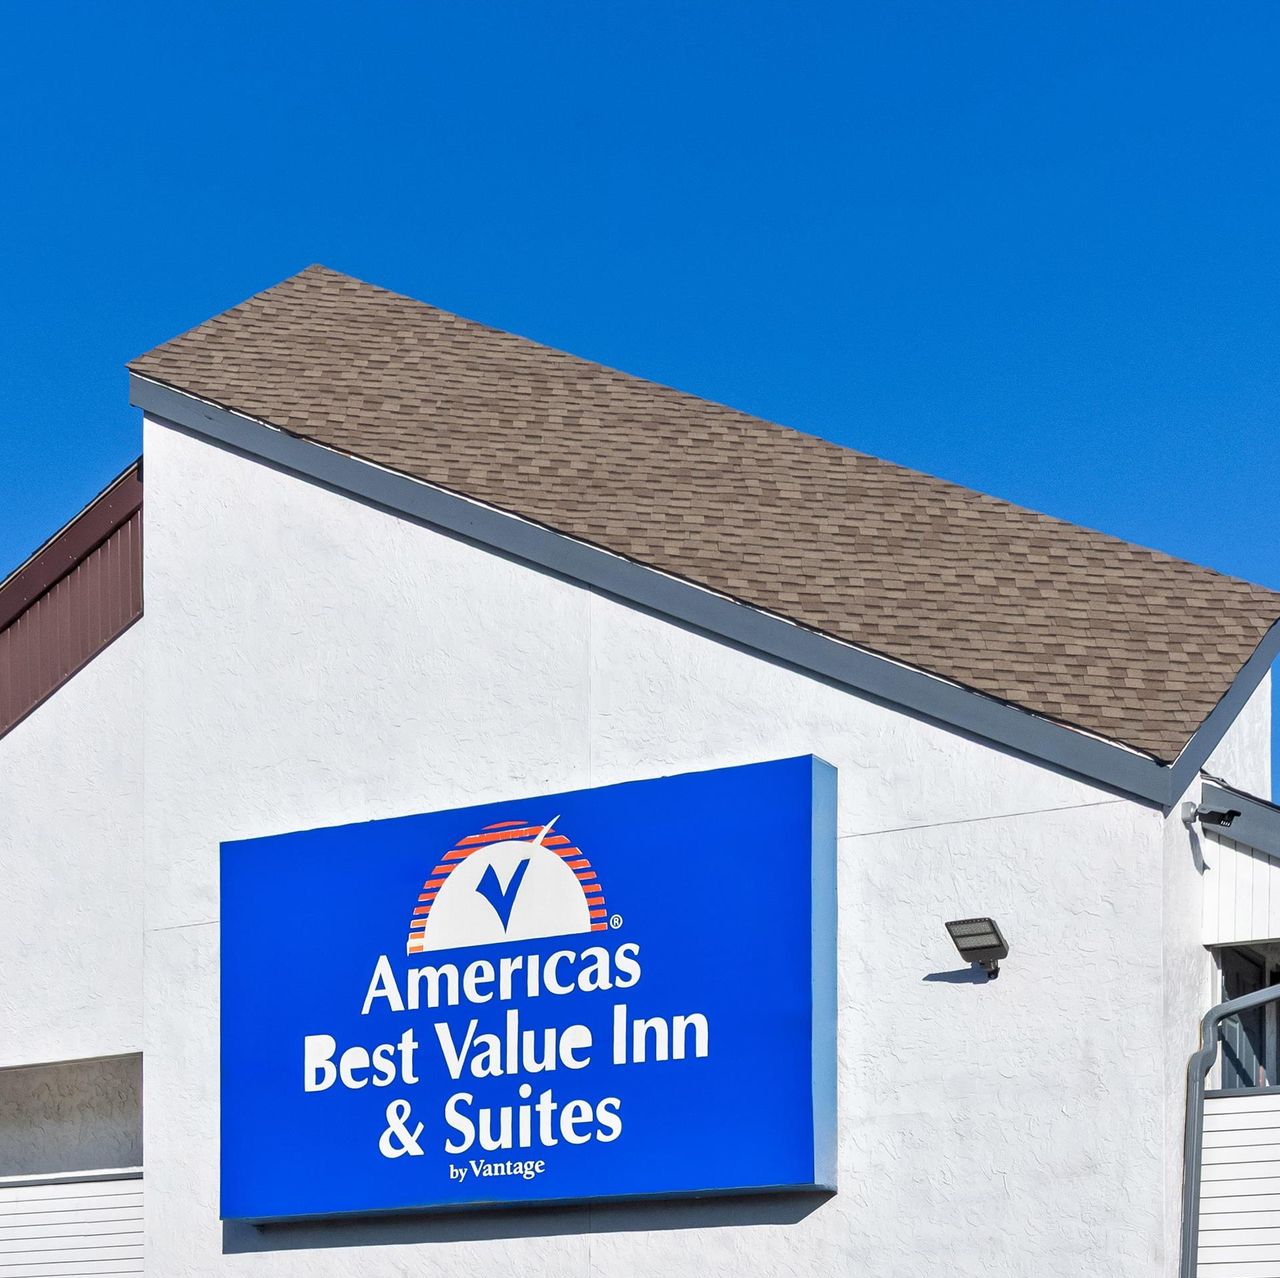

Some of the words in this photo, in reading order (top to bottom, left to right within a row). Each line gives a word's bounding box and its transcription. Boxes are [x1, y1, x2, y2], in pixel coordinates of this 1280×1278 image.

[361, 942, 641, 1015] Americas
[304, 1028, 419, 1092] Best
[433, 1008, 593, 1080] Value
[613, 1003, 709, 1065] Inn
[378, 1098, 425, 1159] &
[444, 1083, 622, 1154] Suites
[449, 1164, 468, 1183] by
[468, 1159, 545, 1180] Vantage
